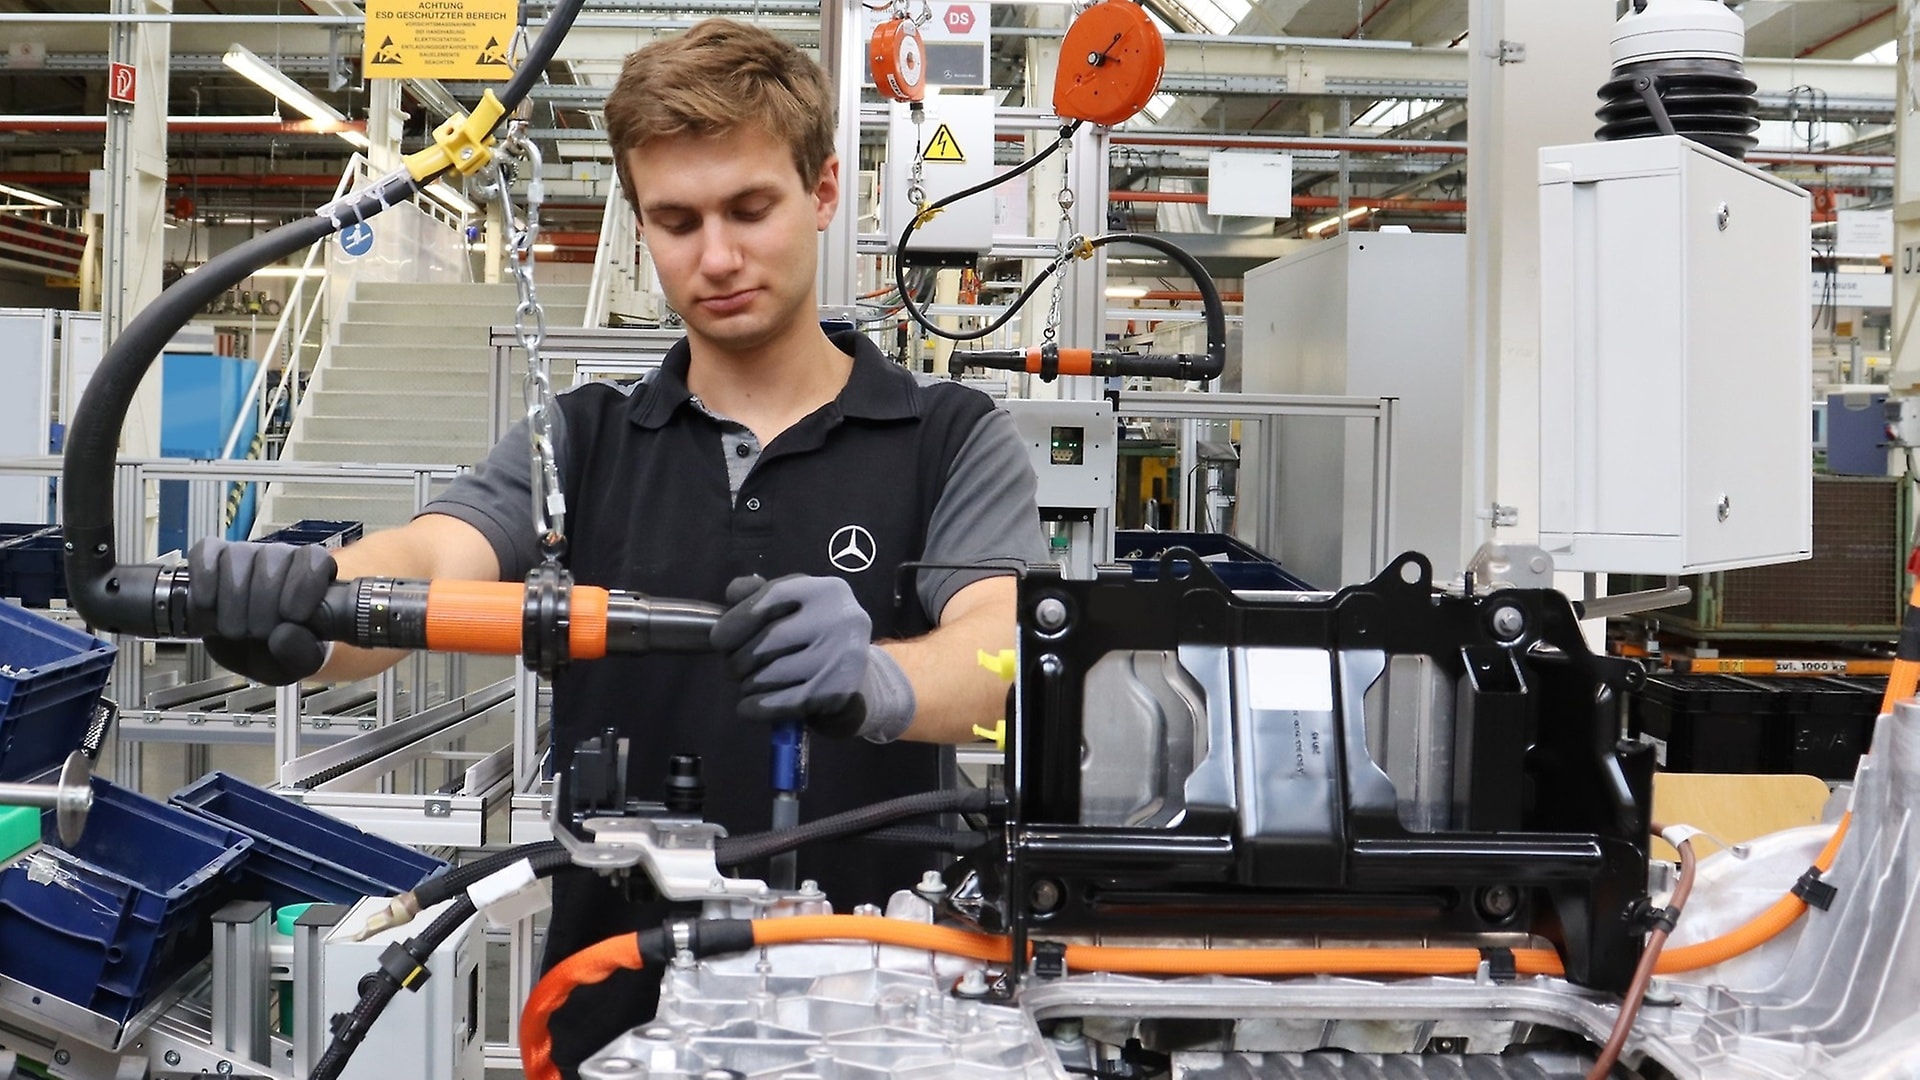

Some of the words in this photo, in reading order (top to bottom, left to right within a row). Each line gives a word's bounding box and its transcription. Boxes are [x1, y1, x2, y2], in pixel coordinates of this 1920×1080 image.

[418, 2, 464, 10] ACHTUNG
[375, 11, 394, 19] ESD
[466, 12, 507, 20] BEREICH
[949, 12, 969, 25] DS
[1802, 662, 1828, 671] 1000
